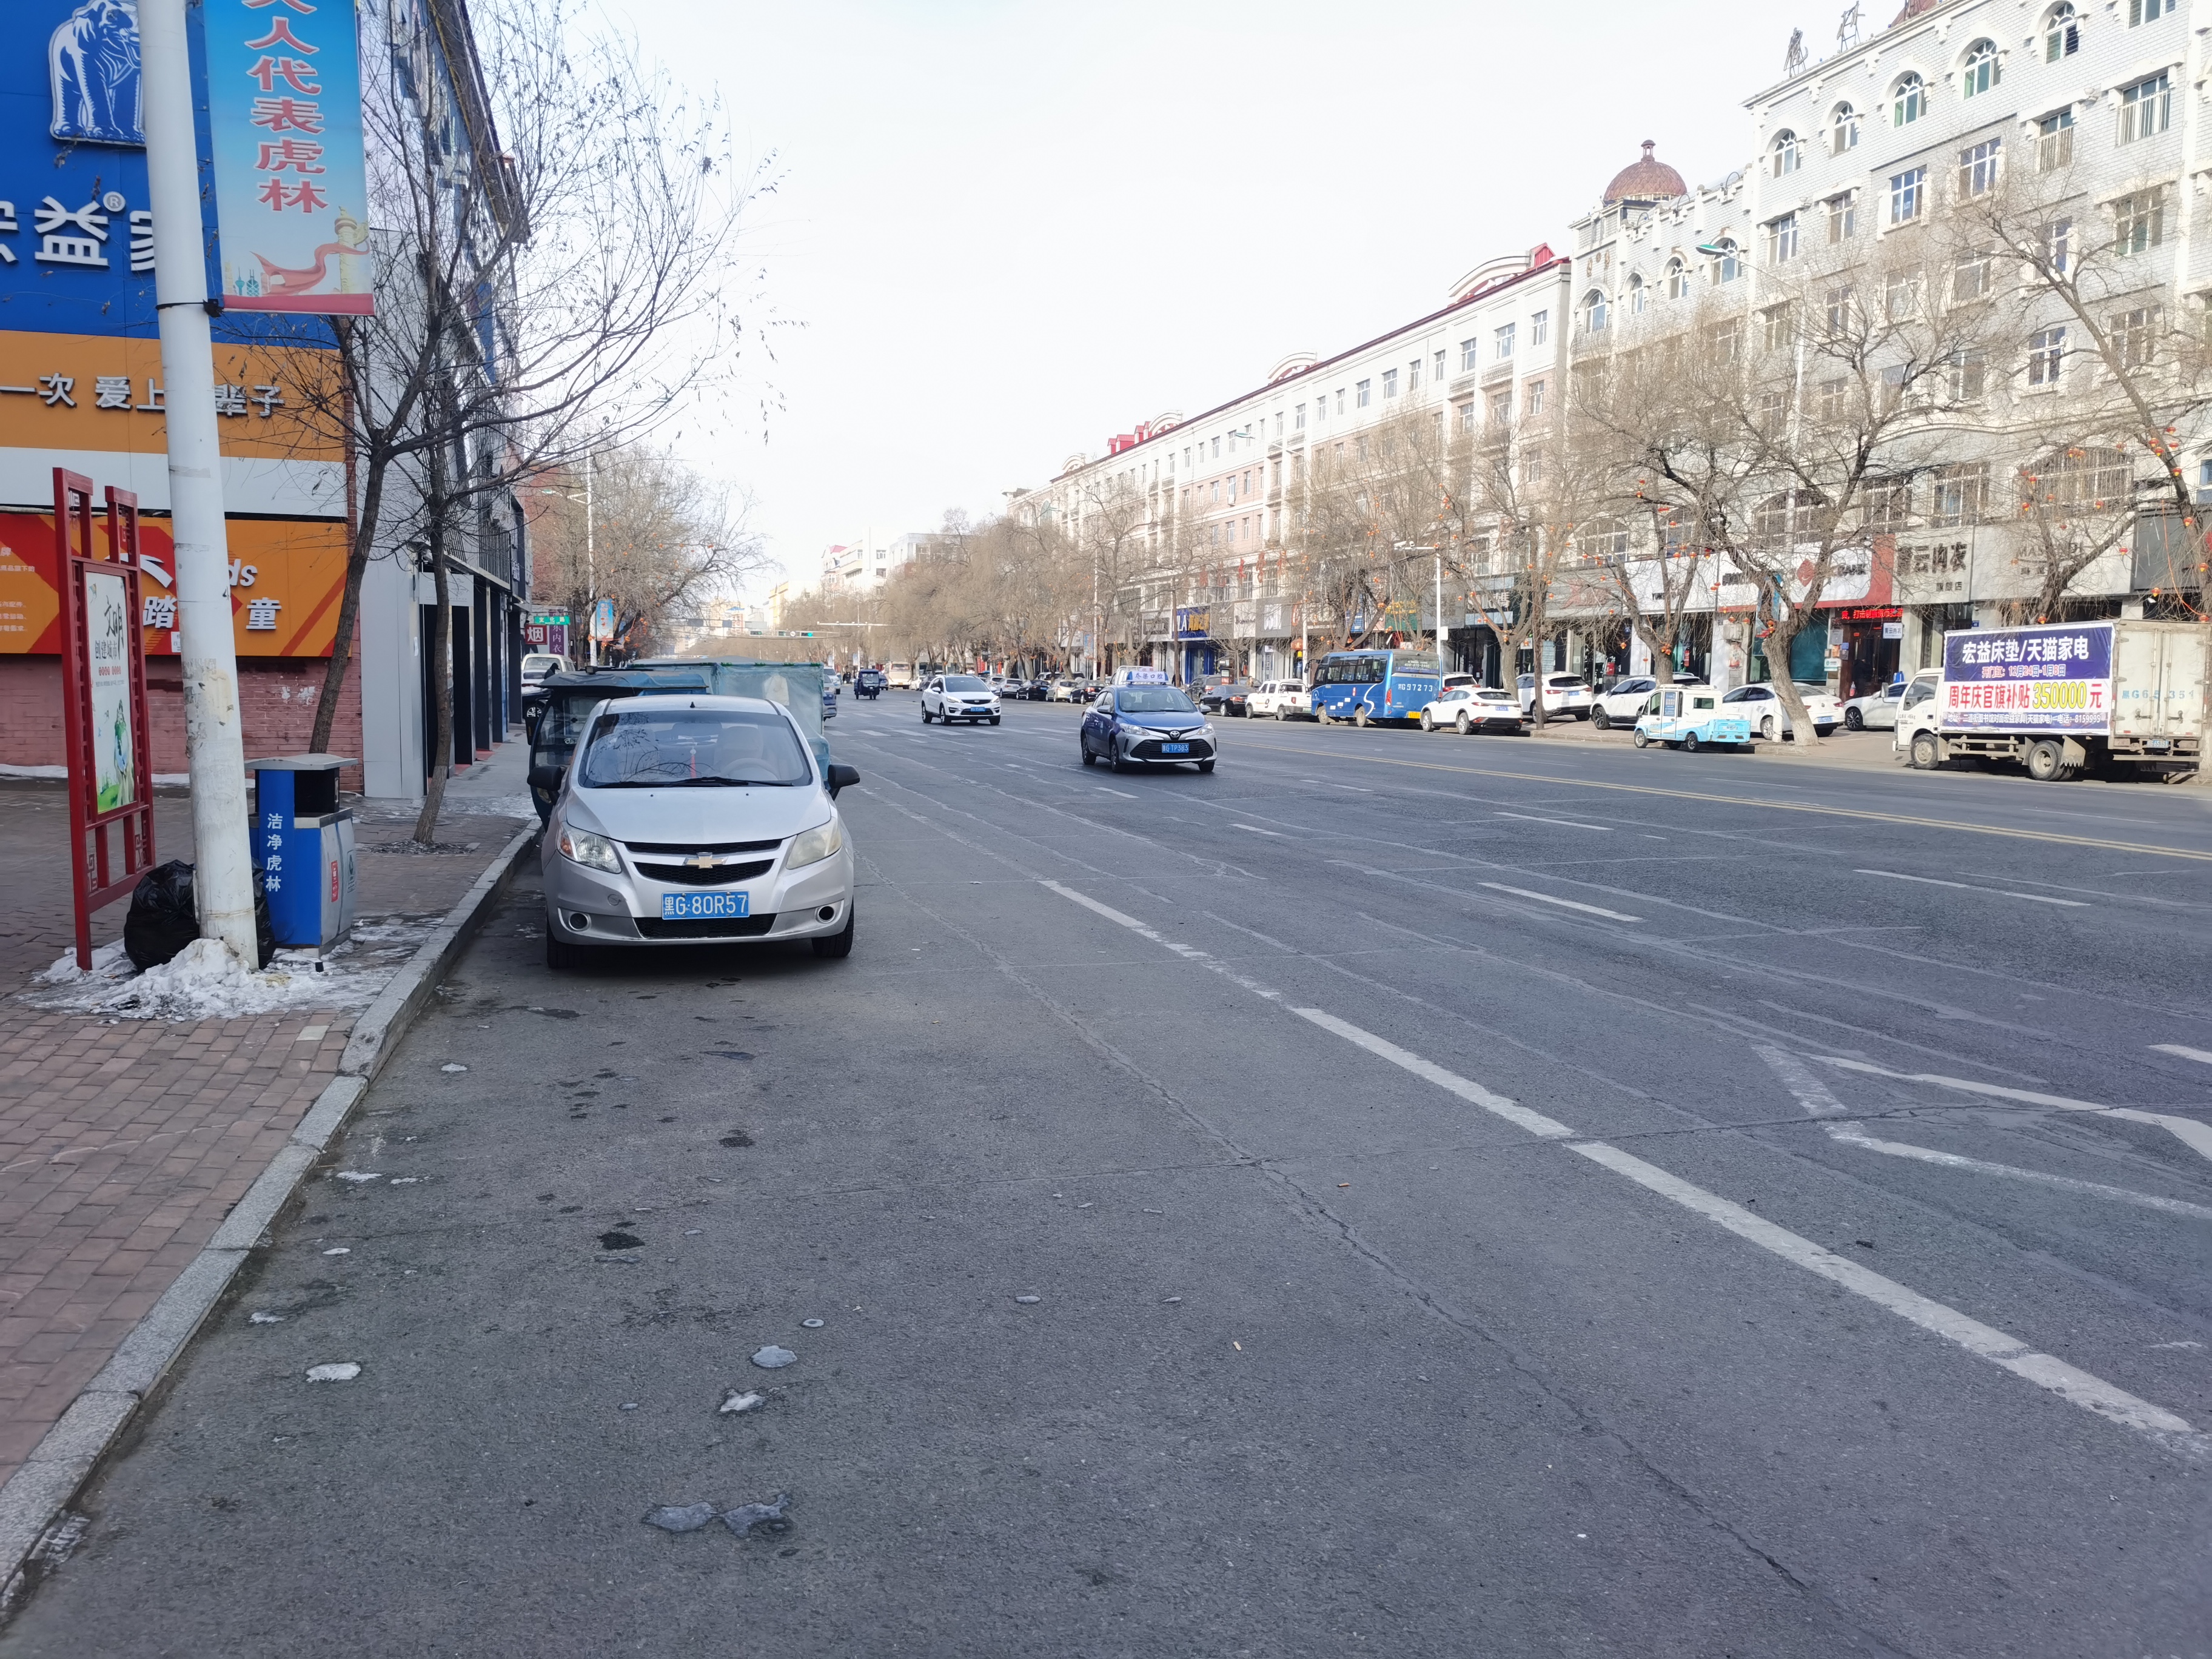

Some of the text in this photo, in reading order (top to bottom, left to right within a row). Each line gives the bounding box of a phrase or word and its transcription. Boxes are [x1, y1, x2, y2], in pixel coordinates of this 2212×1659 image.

[527, 626, 544, 642] 烟
[1963, 635, 2090, 664] 宏益床垫/天猫家电
[1398, 683, 1433, 692] 黑G97273
[266, 813, 283, 892] 洁净虎林
